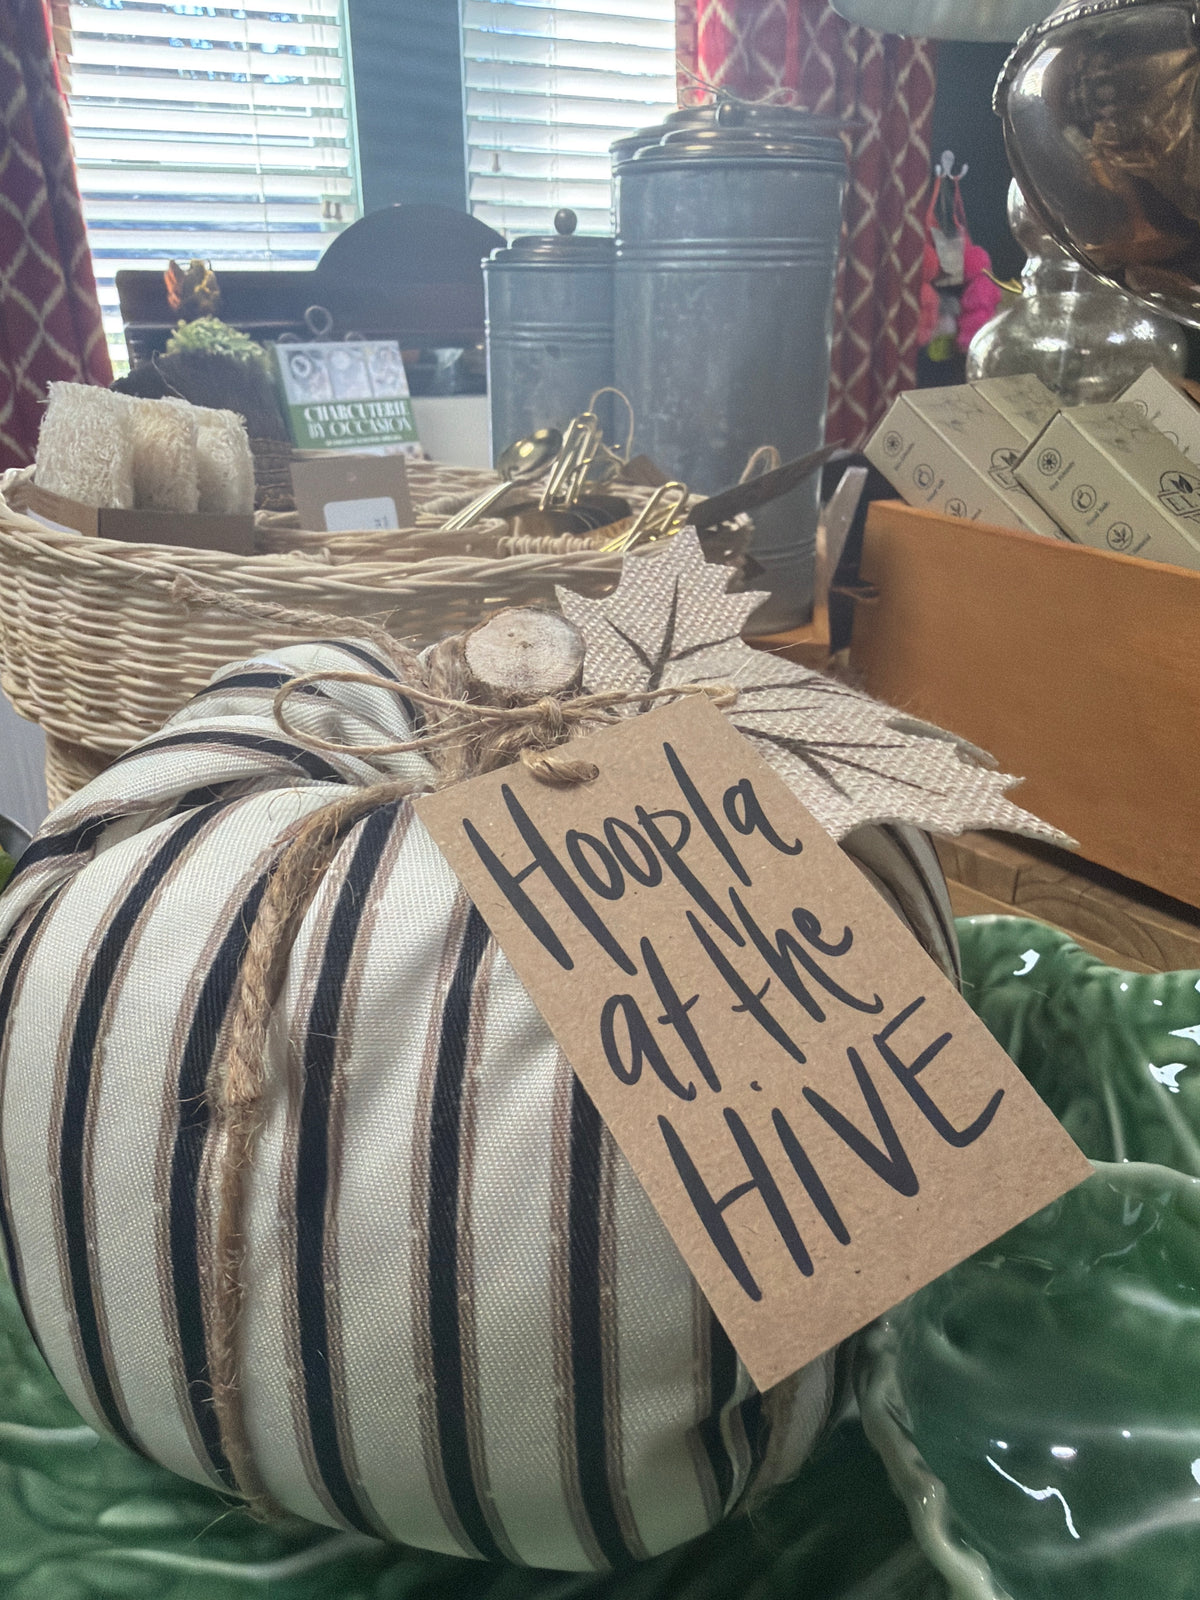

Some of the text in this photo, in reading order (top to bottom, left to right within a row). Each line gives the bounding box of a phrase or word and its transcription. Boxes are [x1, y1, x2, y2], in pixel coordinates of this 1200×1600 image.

[304, 400, 410, 421] CHARCUTERIE
[307, 416, 412, 439] BY OCCASION
[463, 743, 802, 975] Hoopla
[601, 887, 884, 1102] at the
